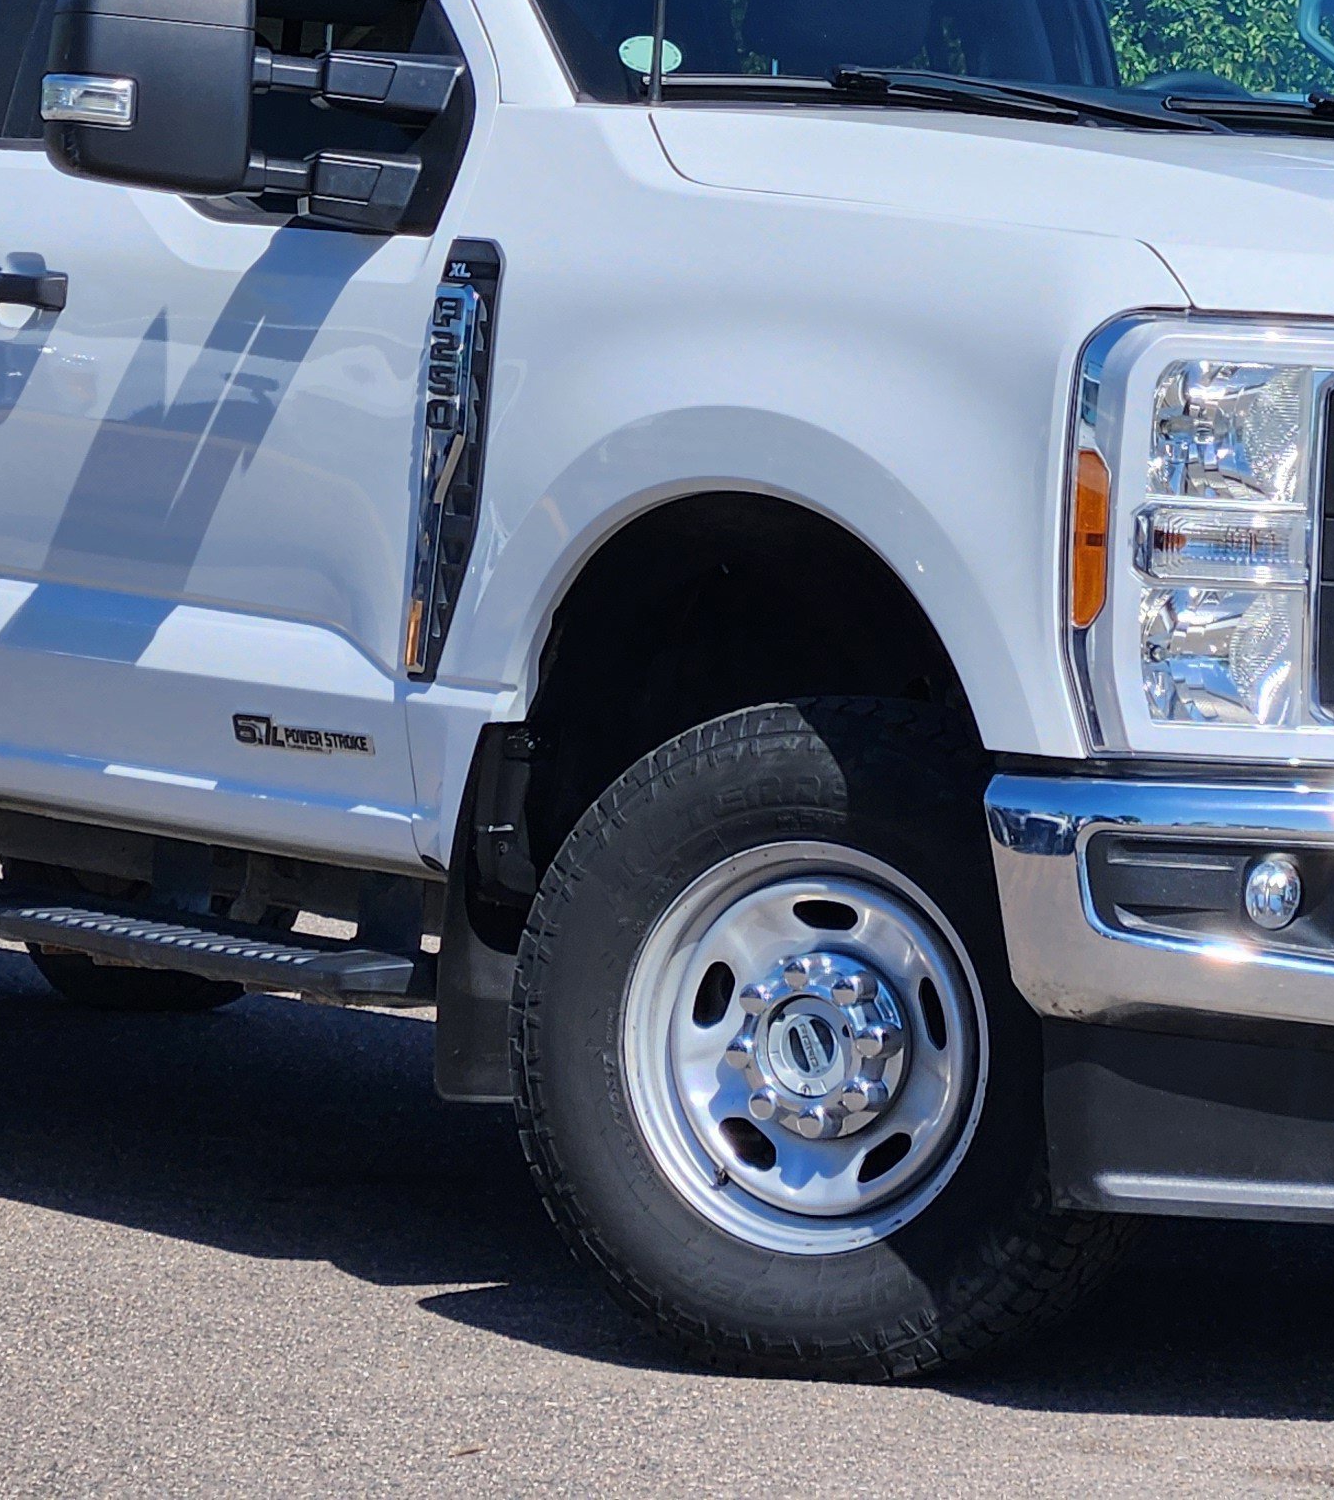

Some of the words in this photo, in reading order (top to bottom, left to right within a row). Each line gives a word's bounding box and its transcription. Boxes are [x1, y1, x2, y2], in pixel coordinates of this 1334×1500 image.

[447, 261, 472, 279] XL
[232, 713, 285, 748] 6.7L
[284, 727, 323, 747] POWER
[324, 731, 369, 753] STROKE
